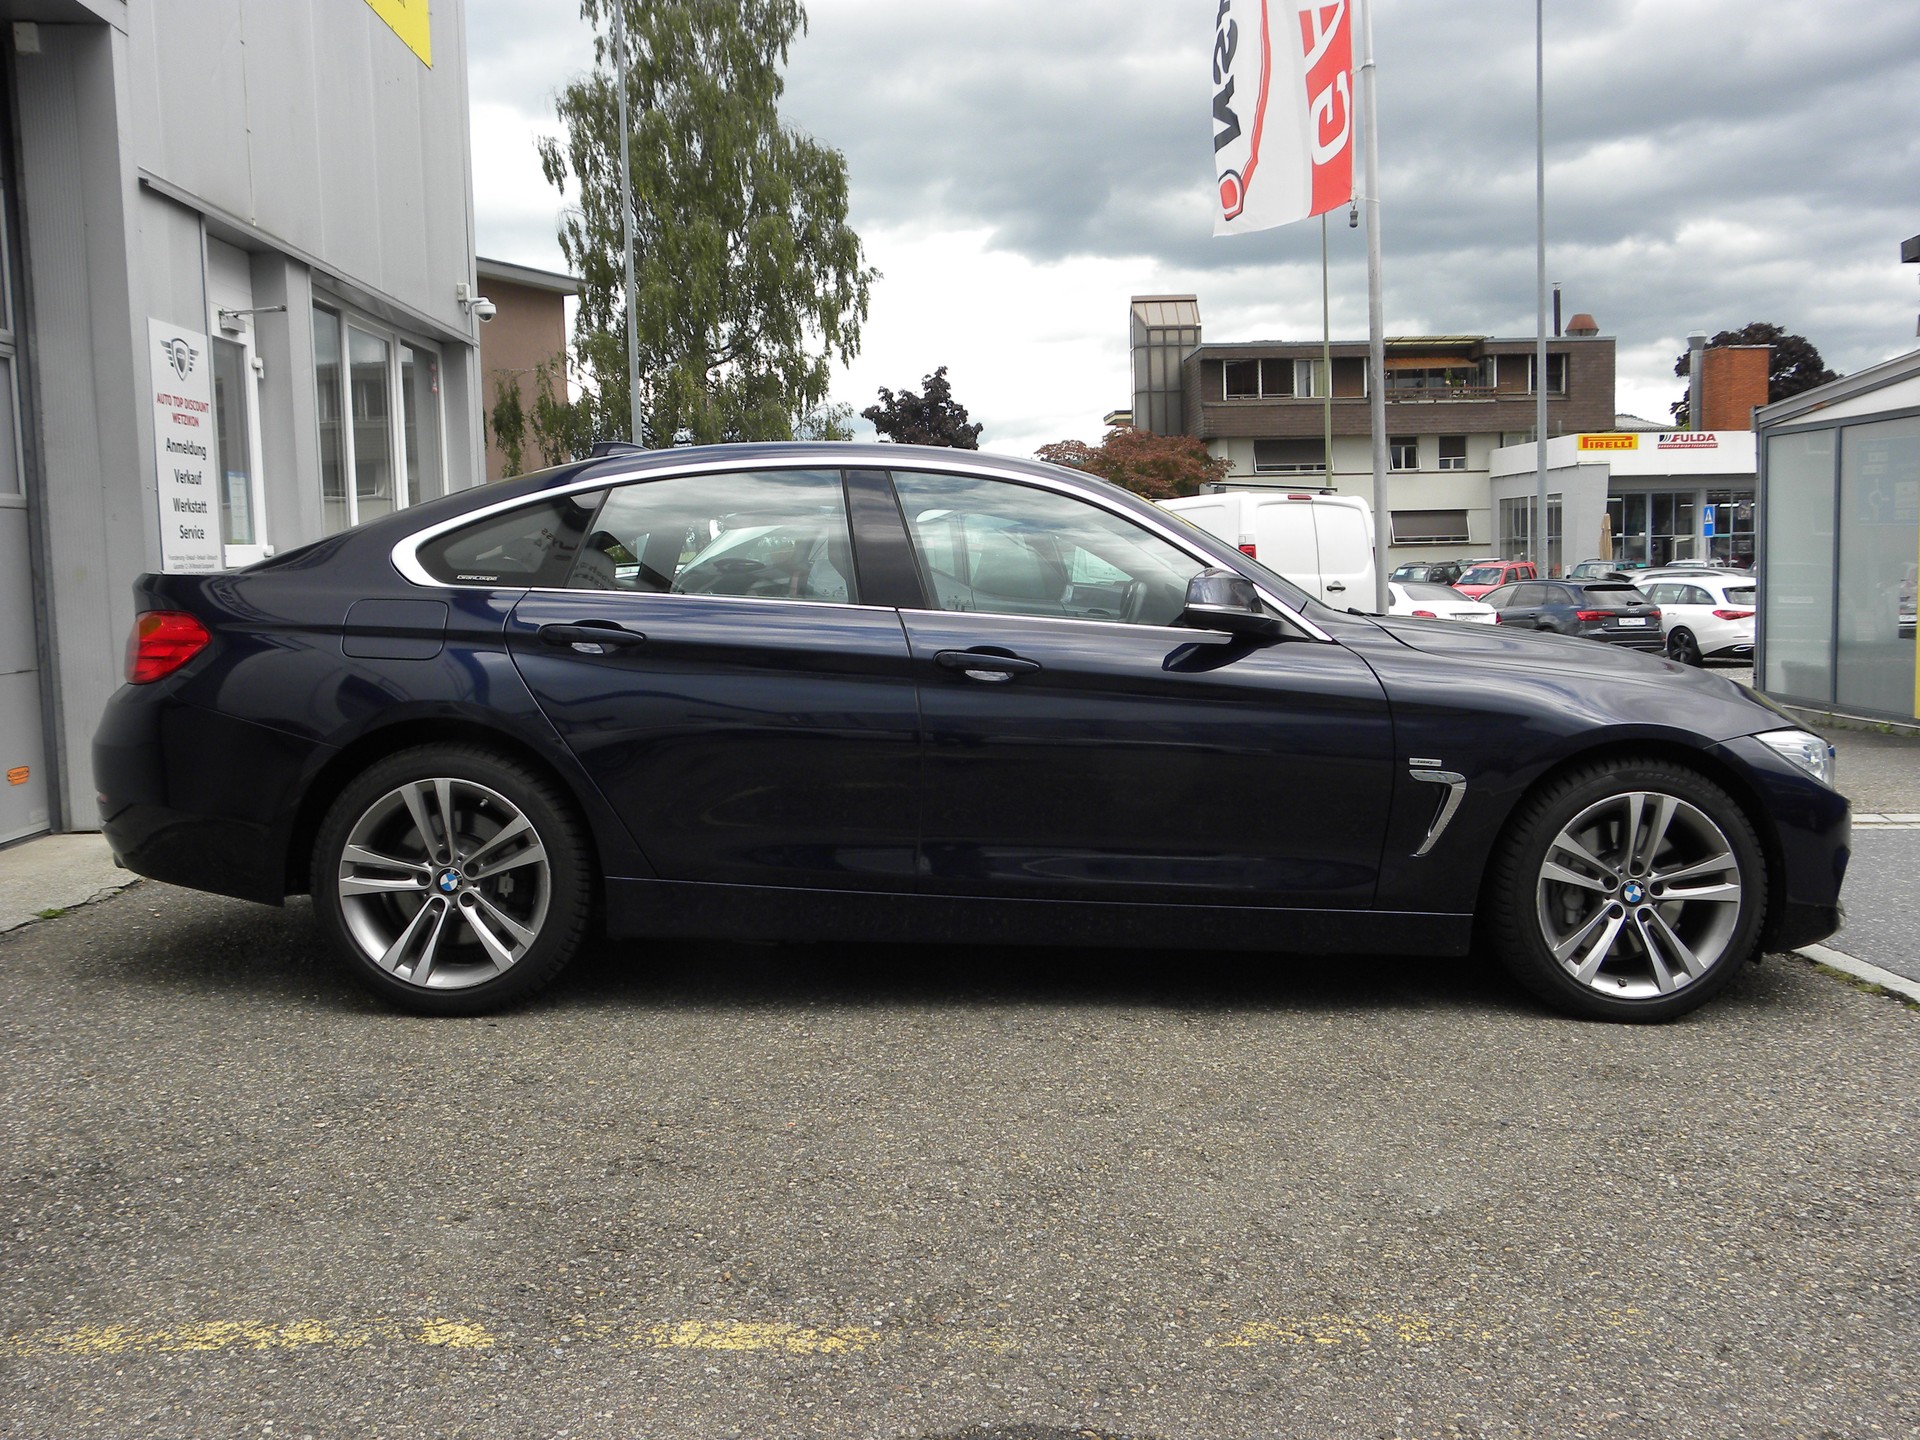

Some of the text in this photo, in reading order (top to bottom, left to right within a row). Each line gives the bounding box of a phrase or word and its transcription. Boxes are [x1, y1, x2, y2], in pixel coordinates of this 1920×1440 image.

[157, 392, 209, 413] AUTO TOP DISCOUNT
[172, 412, 199, 427] WETZIKON
[1582, 435, 1633, 449] PIRELLI
[1671, 434, 1716, 442] FULDA
[166, 437, 206, 460] Anmeldung
[174, 468, 202, 485] Verkauf
[173, 497, 208, 513] Werkstatt
[180, 524, 205, 539] Service
